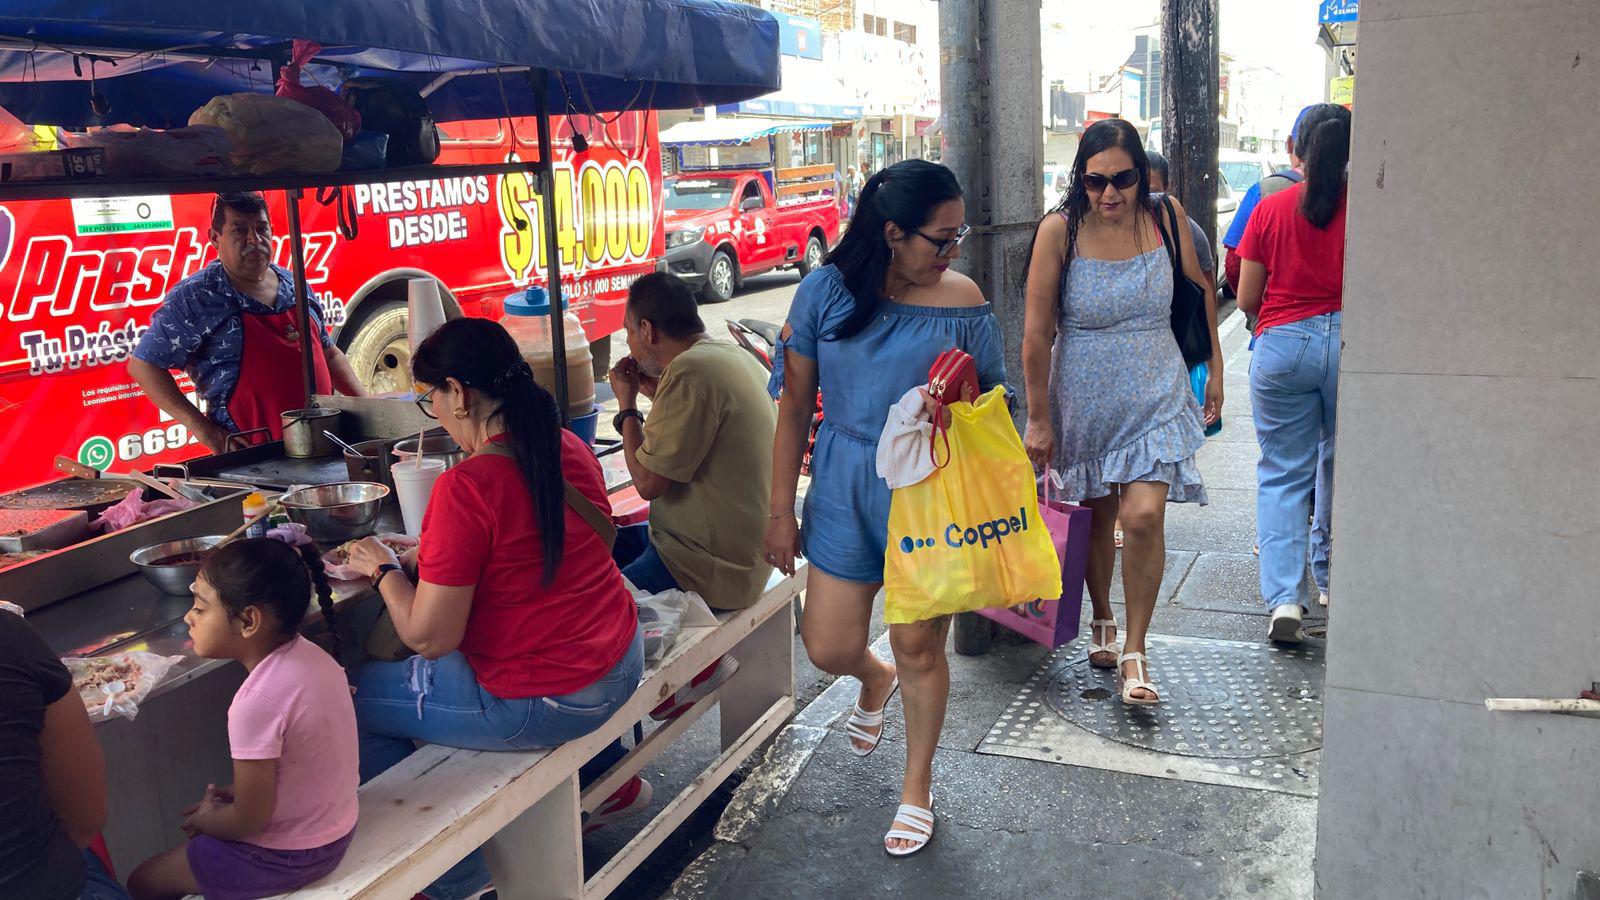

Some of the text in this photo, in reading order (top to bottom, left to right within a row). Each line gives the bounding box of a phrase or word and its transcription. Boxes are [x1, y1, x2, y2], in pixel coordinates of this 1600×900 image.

[354, 175, 490, 215] PRESTAMOS
[82, 225, 126, 233] REPORTES
[388, 211, 468, 249] DESDE:
[497, 157, 653, 286] $14,000
[583, 278, 609, 298] $1,000
[20, 329, 64, 376] Tu
[82, 388, 96, 398] Los
[97, 383, 130, 395] requisitos
[82, 395, 118, 407] Leonismo
[944, 506, 1028, 549] Coppel
